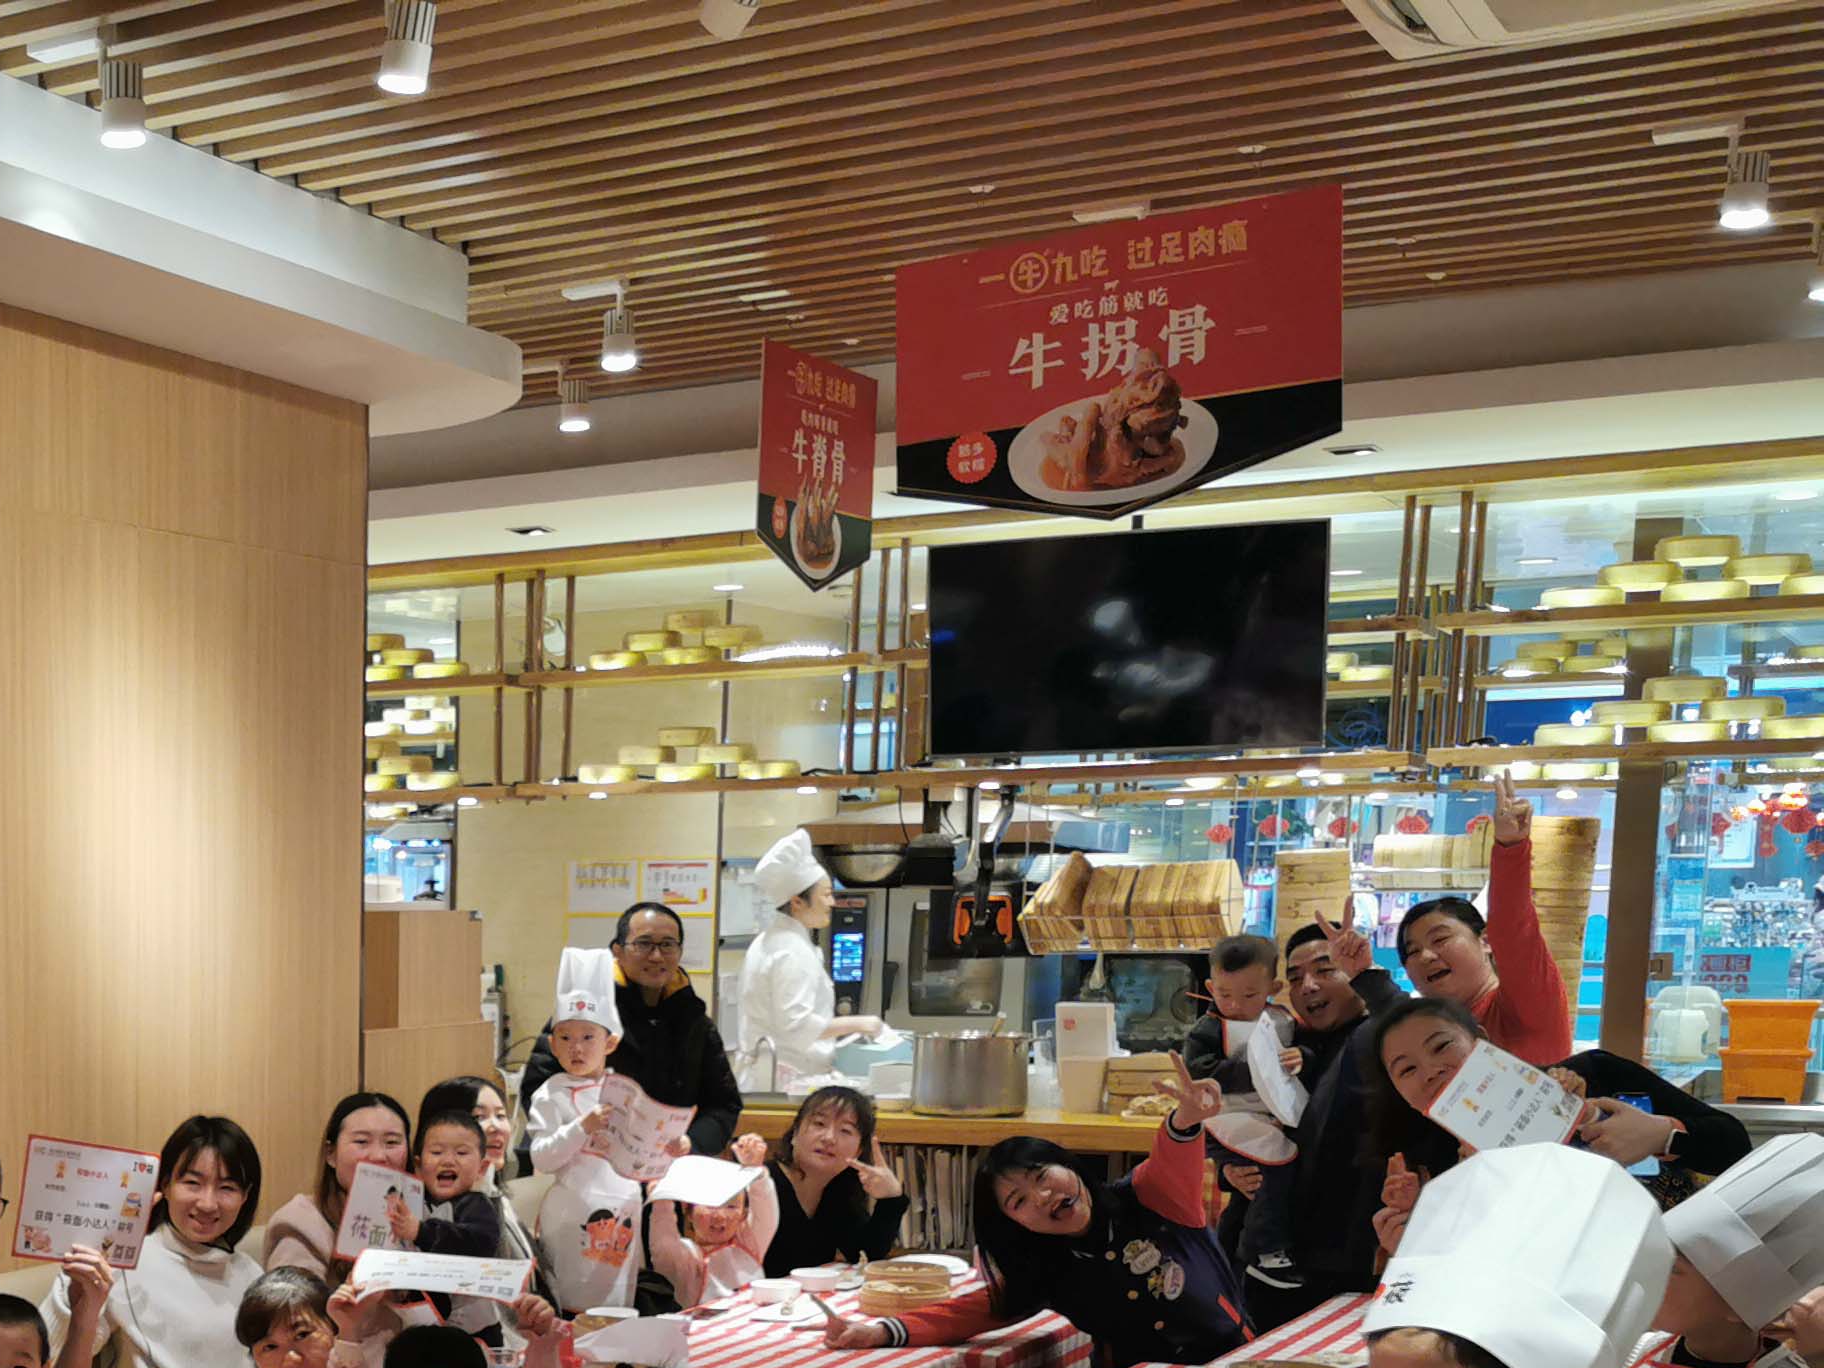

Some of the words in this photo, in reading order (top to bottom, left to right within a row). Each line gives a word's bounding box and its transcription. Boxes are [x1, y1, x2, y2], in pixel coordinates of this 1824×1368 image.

[1127, 220, 1248, 270] 过足肉瘾
[1008, 304, 1217, 390] 牛拐骨
